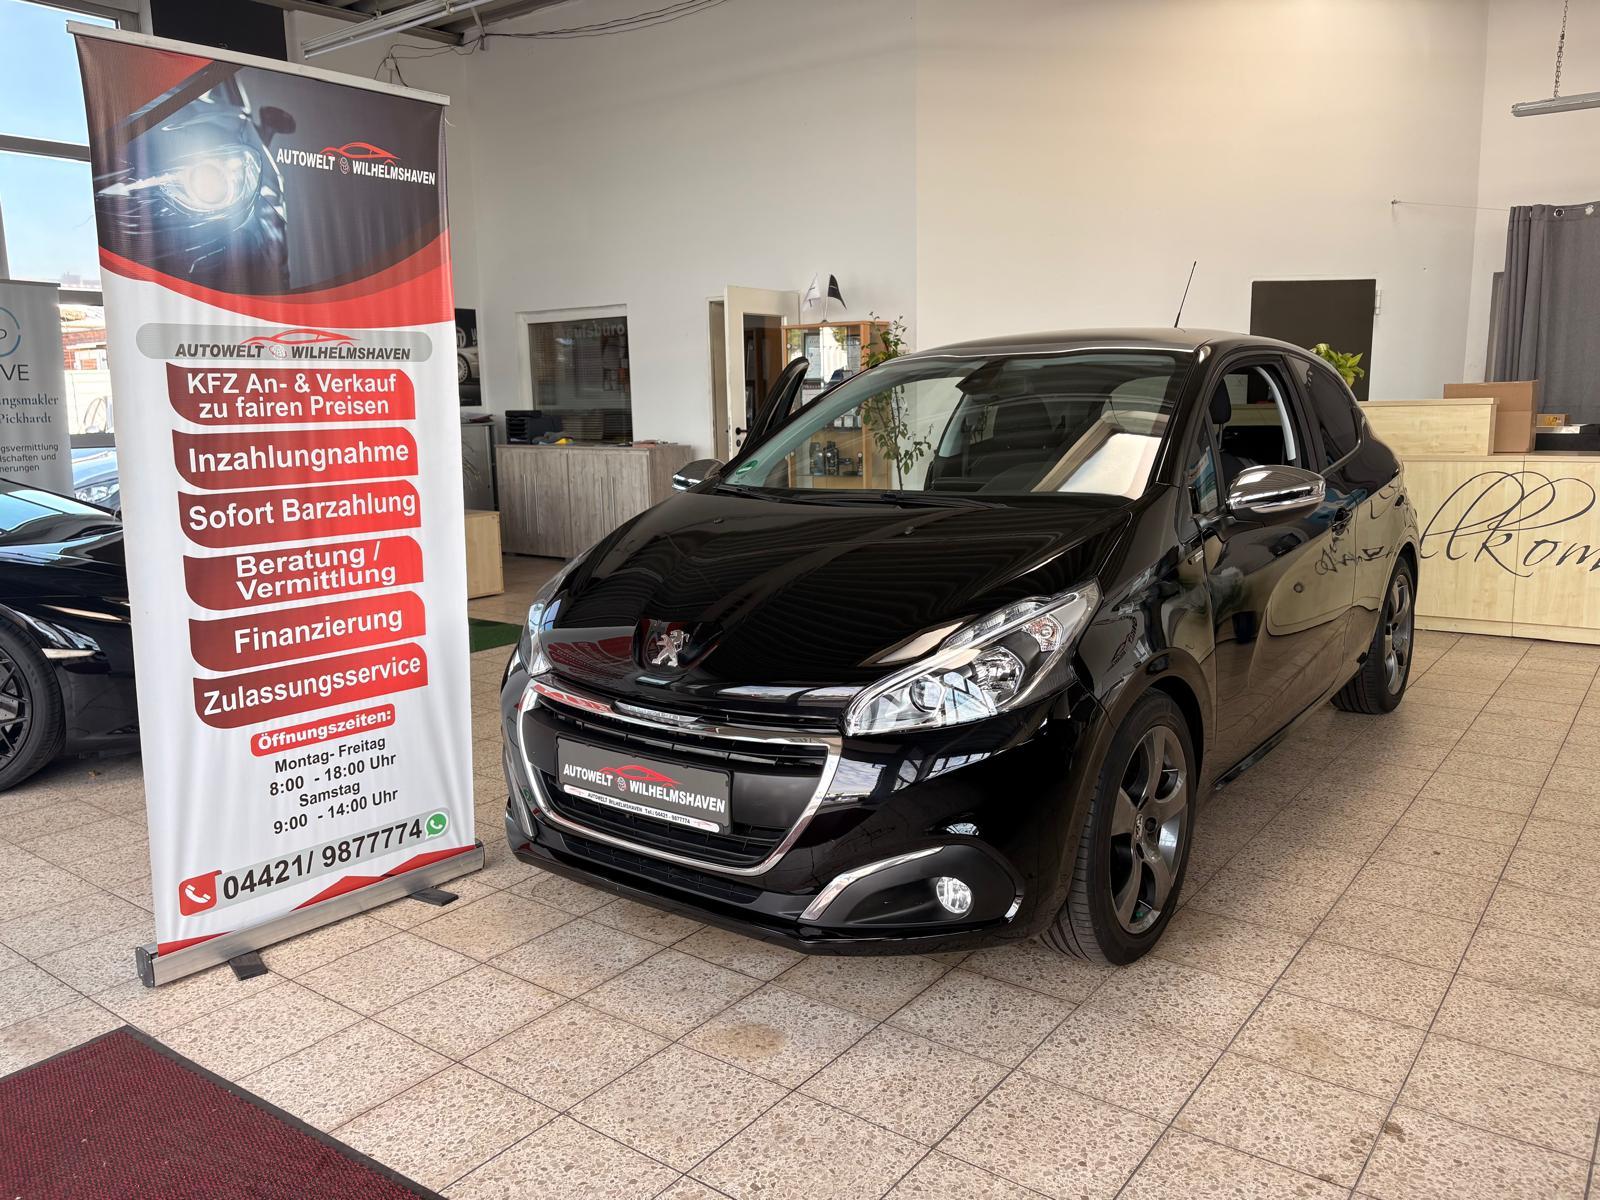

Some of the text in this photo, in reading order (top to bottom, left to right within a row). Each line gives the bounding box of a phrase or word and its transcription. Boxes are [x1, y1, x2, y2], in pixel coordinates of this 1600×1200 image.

[277, 148, 436, 186] AUTOWELT WILHELMSHAVEN
[175, 343, 411, 360] AUTOWELT WILHELMSHAVEN
[0, 393, 59, 409] ngsmakler
[187, 373, 397, 395] KFZ An- & Verkauf
[199, 395, 389, 418] zu fairen Preisen
[41, 453, 57, 461] und
[189, 441, 409, 473] Inzahlungnahme
[189, 492, 416, 531] Sofort Barzahlung
[236, 546, 366, 578] Beratung
[236, 565, 397, 601] Vermittlung
[234, 609, 403, 654] Finanzierung
[203, 656, 421, 716] Zulassungsservice
[258, 710, 392, 750] Öffnungszeiten:
[270, 775, 304, 796] 8:00
[324, 760, 365, 782] 18:00
[369, 752, 397, 770] Uhr
[275, 737, 386, 774] Montag- Freitag
[299, 781, 361, 807] Samstag
[563, 763, 726, 813] AUTOWELT WILHELMSHAVEN
[273, 813, 308, 834] 9:00
[327, 797, 368, 820] 14:00
[372, 789, 398, 807] Uhr
[223, 818, 423, 900] 04421/ 9877774
